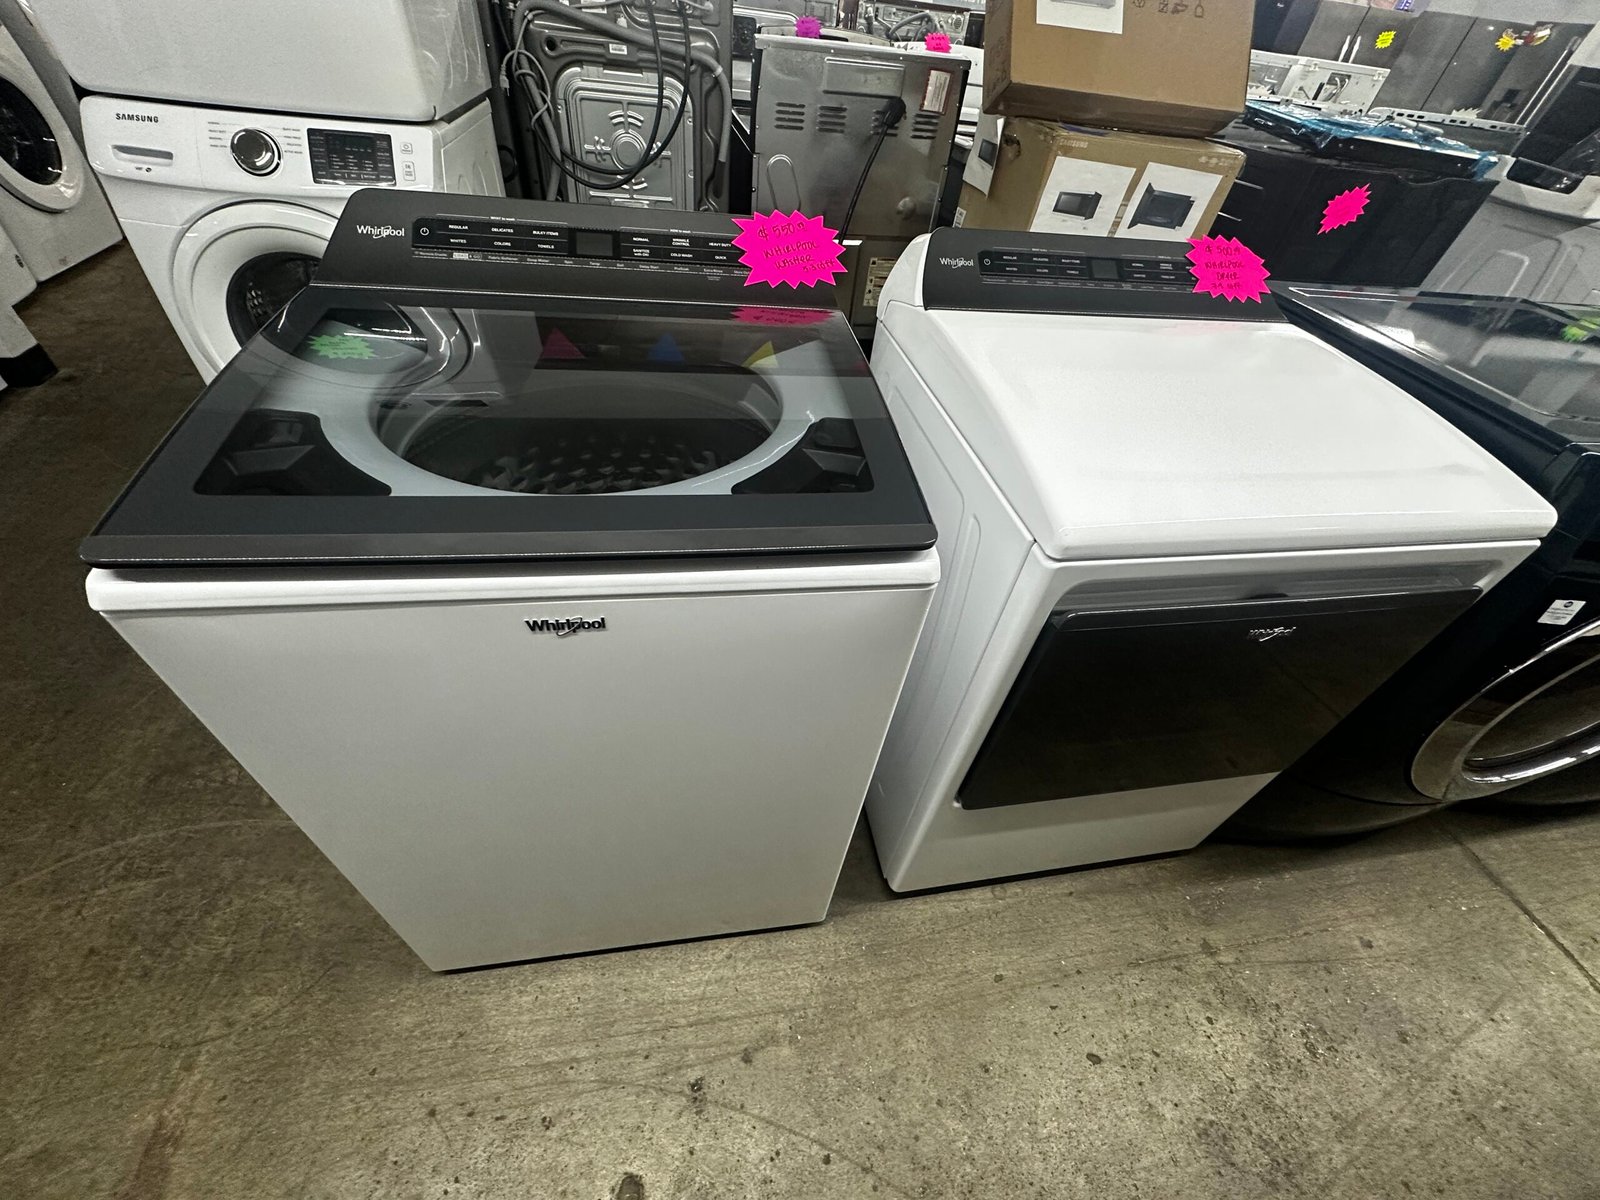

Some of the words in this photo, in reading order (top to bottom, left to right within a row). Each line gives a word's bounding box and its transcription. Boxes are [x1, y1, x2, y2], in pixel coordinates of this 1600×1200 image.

[116, 112, 159, 124] SAMSUNG
[356, 224, 405, 239] Whirlpool
[758, 224, 768, 241] $
[763, 240, 820, 259] WHIRLPOOL
[775, 254, 814, 269] WASHER
[939, 257, 974, 269] Whirlpool
[1204, 260, 1244, 269] WHIRLPOOL
[524, 616, 606, 636] Whirlpool
